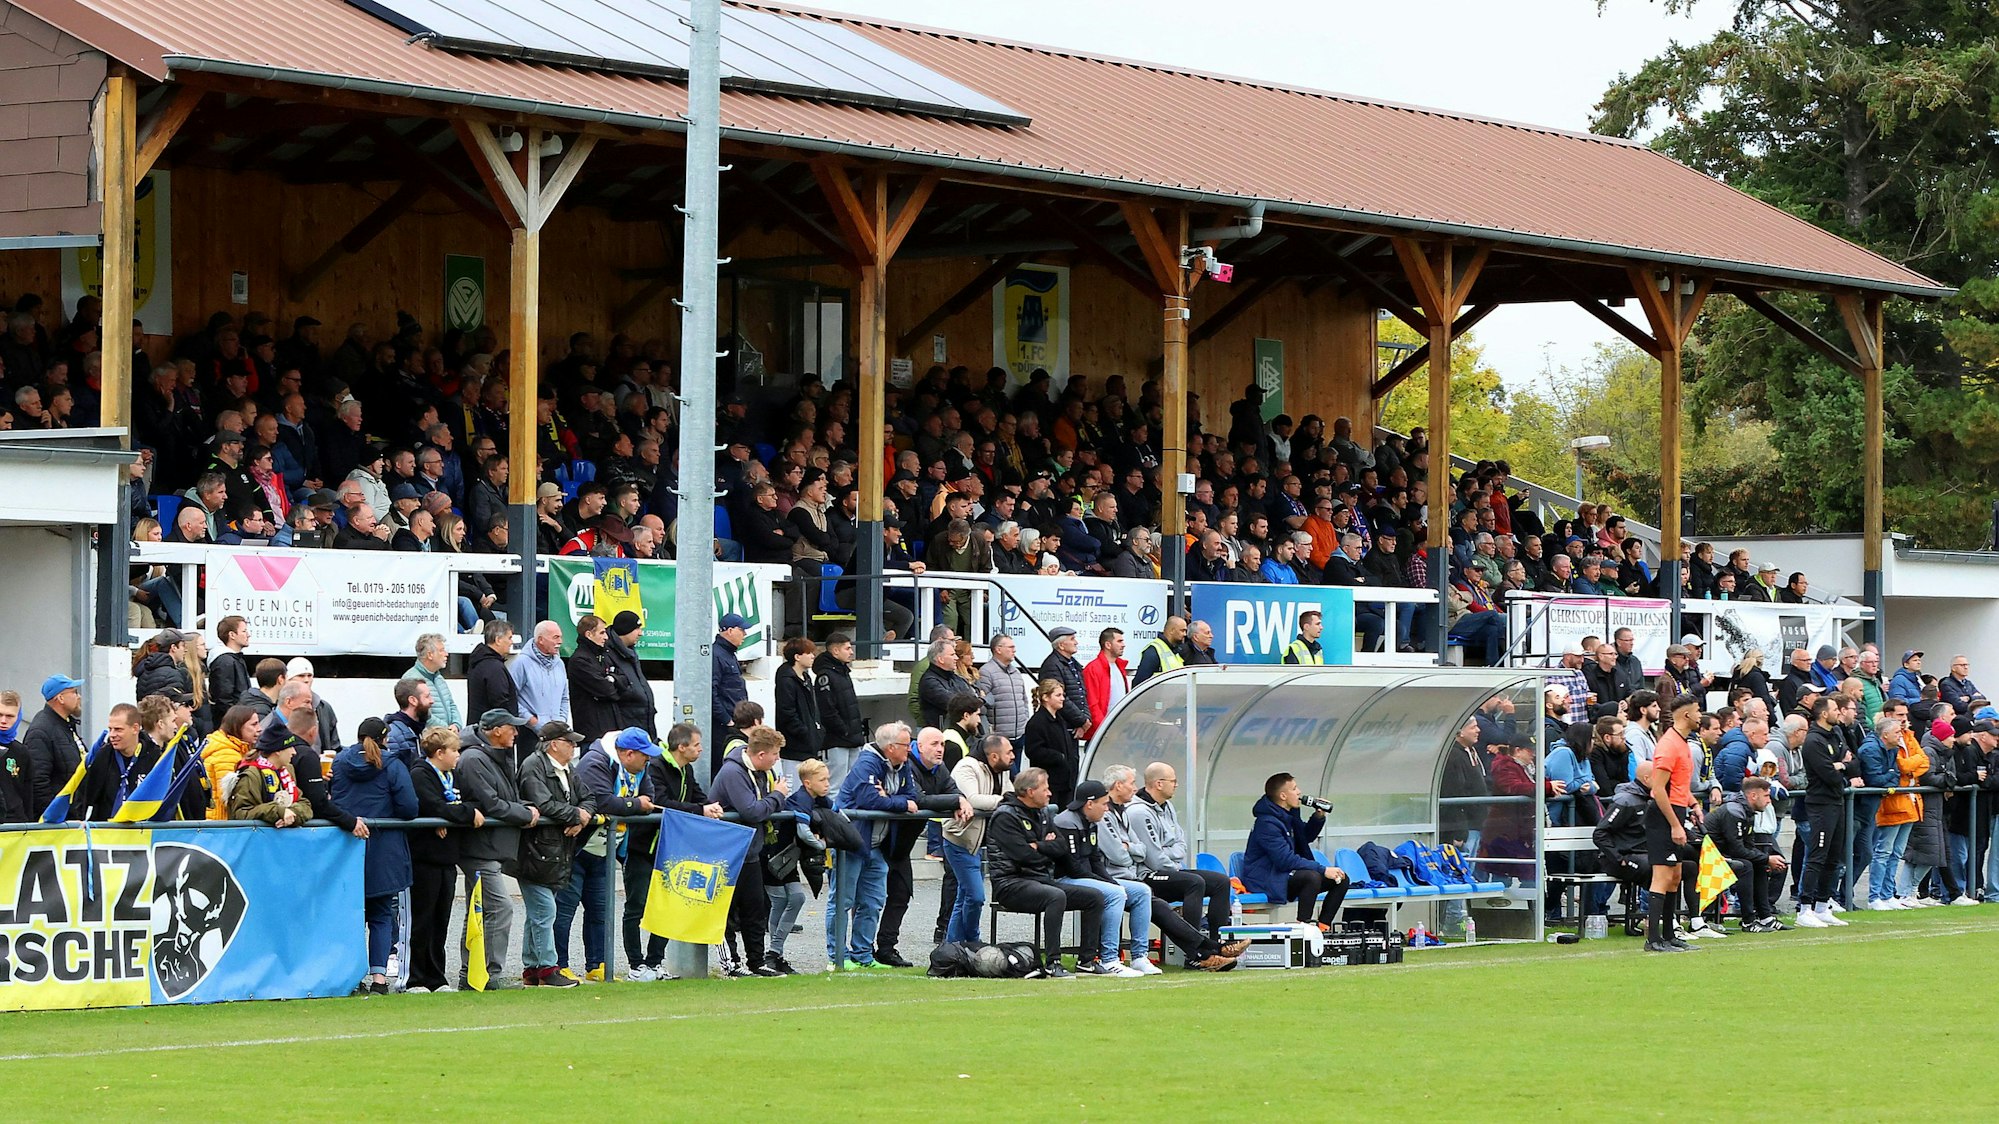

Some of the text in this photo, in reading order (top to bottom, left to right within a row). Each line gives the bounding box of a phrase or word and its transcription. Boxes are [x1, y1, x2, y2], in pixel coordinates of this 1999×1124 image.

[347, 582, 362, 593] Tel.
[363, 582, 384, 594] 0179
[391, 583, 405, 594] 205
[407, 583, 426, 594] 1056
[222, 598, 313, 613] GEUENICH
[332, 598, 439, 611] info@geuenich-bedachungen.de
[225, 614, 313, 628] ACHUNGEN
[333, 612, 439, 624] www.geuenich-bedachungen.de
[1032, 610, 1064, 622] Autohaus
[1065, 610, 1087, 623] Rudolf
[1089, 611, 1113, 624] Sazma
[1612, 608, 1669, 626] RÜHLMANN
[992, 626, 1026, 637] HYNDAI
[1133, 630, 1157, 639] HYUND
[1782, 626, 1806, 636] PUSH
